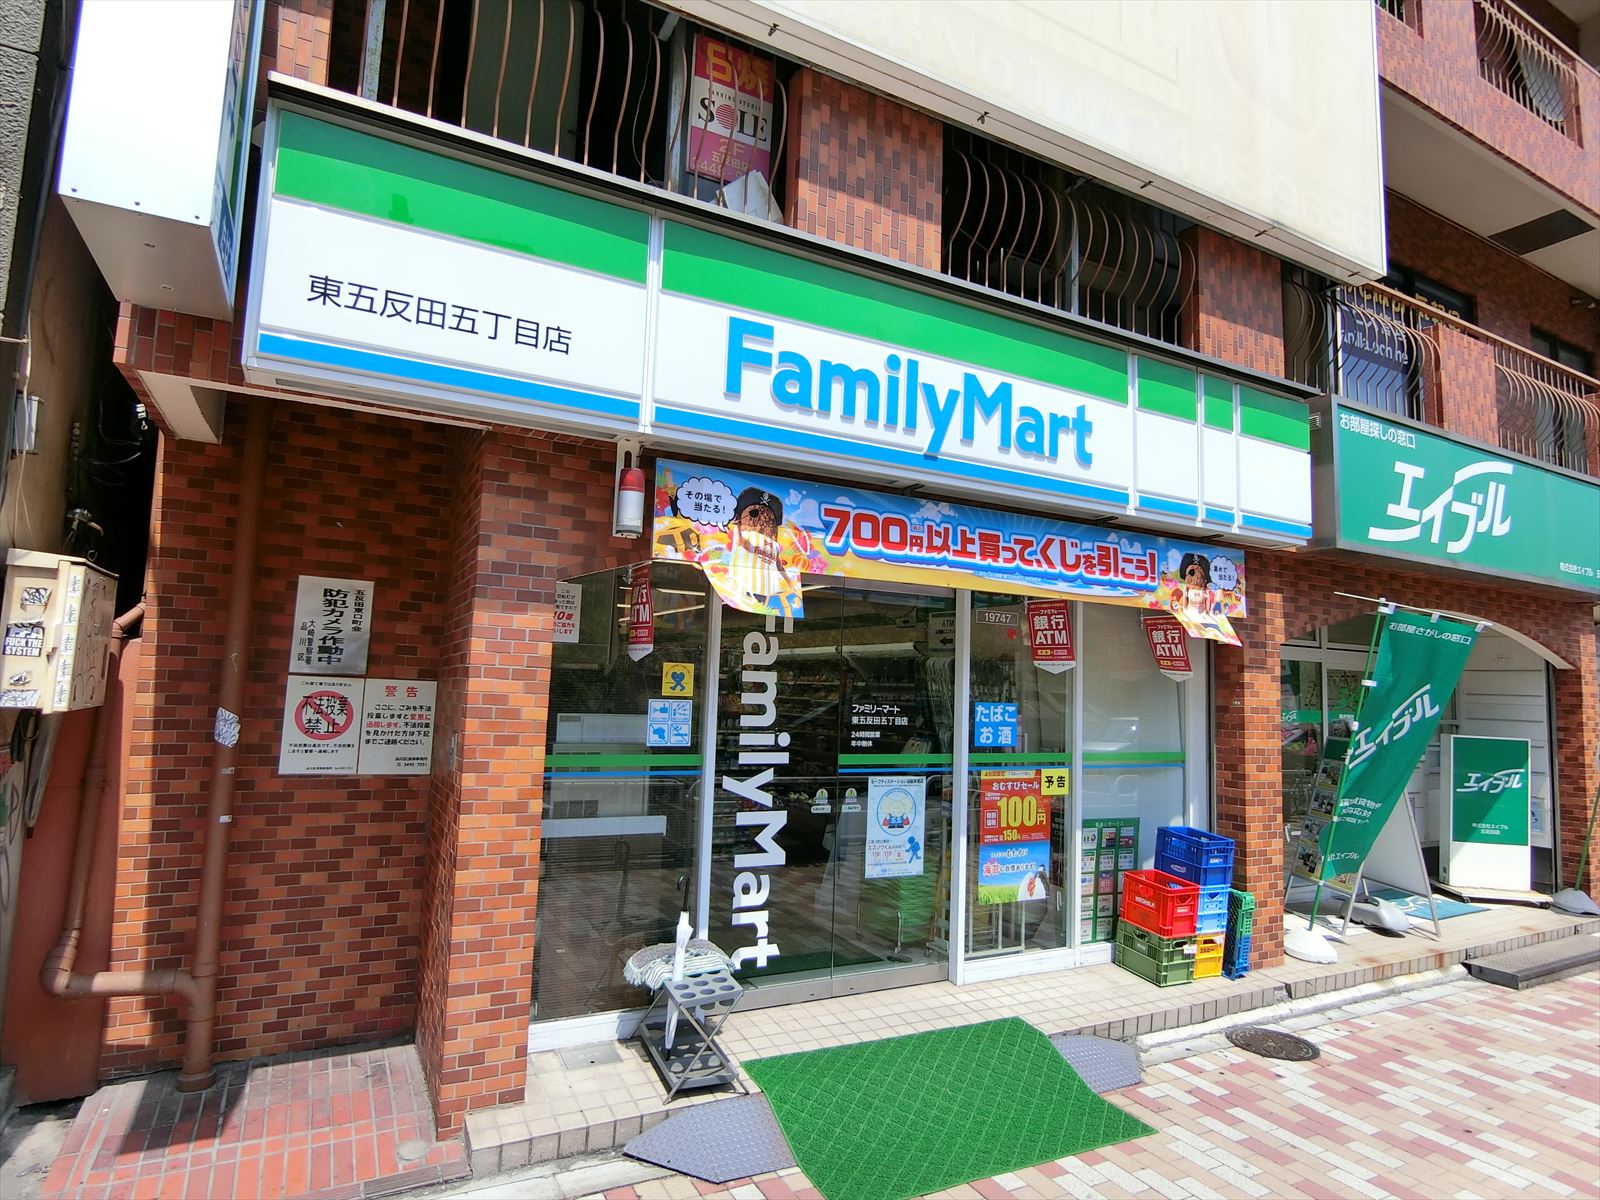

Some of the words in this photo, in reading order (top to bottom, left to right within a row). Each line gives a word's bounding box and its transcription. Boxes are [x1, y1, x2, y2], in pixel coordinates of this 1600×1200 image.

[307, 274, 572, 355] 東五反田五丁目店
[724, 315, 1093, 466] FamilyMart
[1340, 413, 1416, 449] お部屋探しの窓口
[685, 490, 722, 504] その場で
[1368, 461, 1514, 554] エイブル
[351, 589, 366, 632] 五反田東口町会
[984, 612, 1012, 624] 19747
[317, 588, 350, 665] 防犯カメラ作動中
[1033, 614, 1065, 630] 銀行
[297, 621, 308, 662] 品川区
[1035, 630, 1067, 645] ATM
[1151, 630, 1180, 643] 銀行
[1389, 622, 1472, 645] お部屋さがしの窓口
[5, 646, 40, 656] SYSTEM
[1156, 644, 1183, 657] ATM
[385, 685, 418, 698] 警告
[302, 695, 348, 716] 不法投棄
[852, 704, 900, 715] ファミリーマート
[976, 704, 1017, 723] たばこ
[305, 717, 341, 734] 禁止
[851, 716, 909, 726] 東五反田五丁目店
[1349, 684, 1440, 770] エイブル
[851, 731, 881, 739] 24時間営業
[980, 726, 1012, 745] お酒
[992, 781, 1039, 791] おむすびセール
[1045, 775, 1066, 789] 予告
[1456, 768, 1525, 793] エイブル
